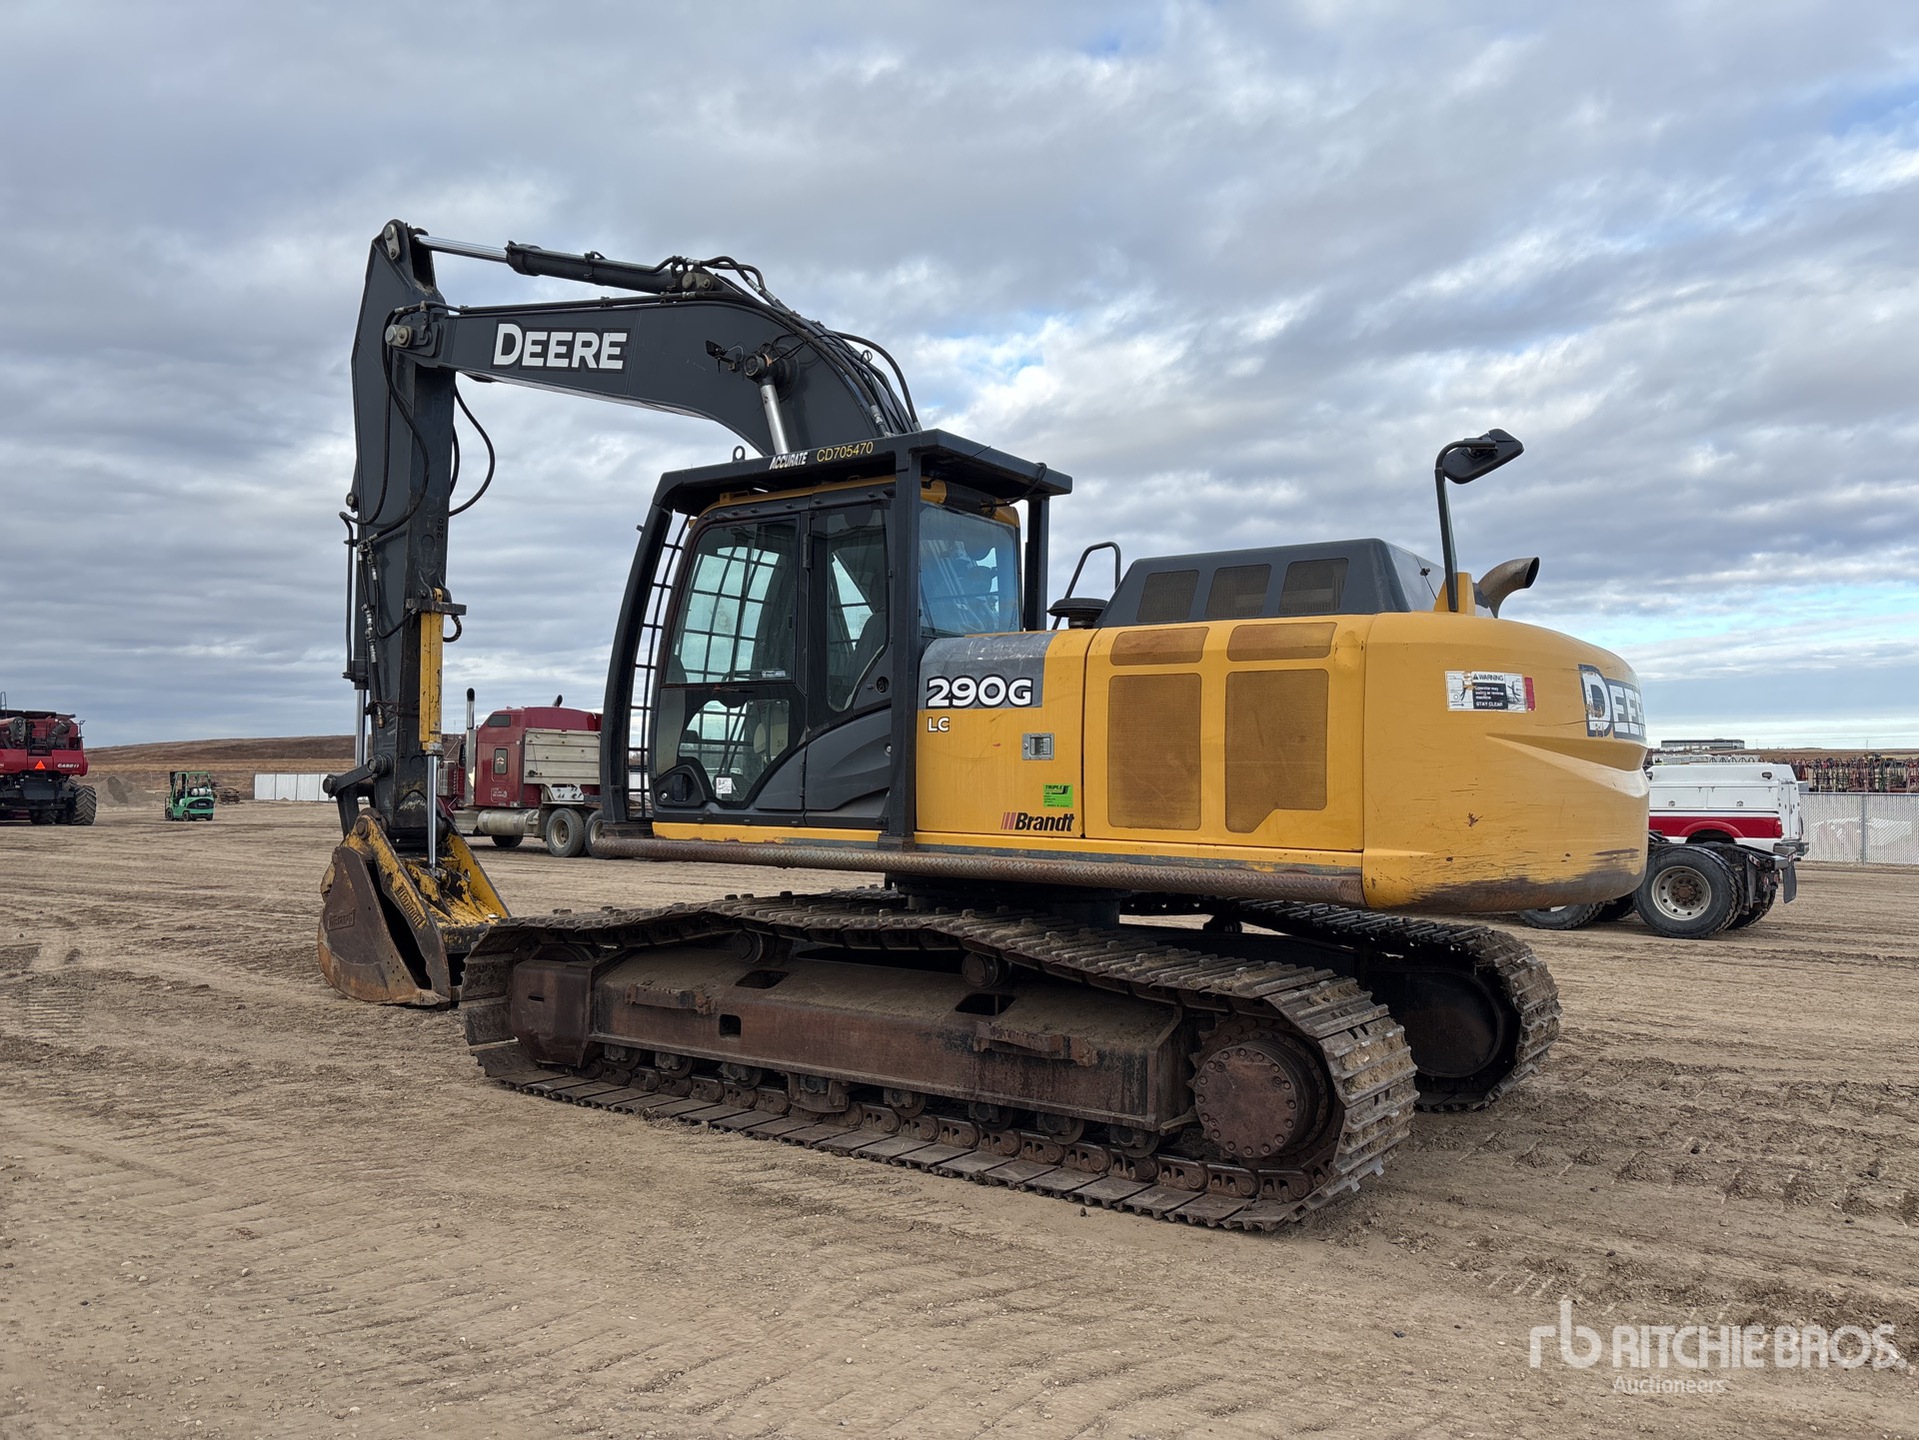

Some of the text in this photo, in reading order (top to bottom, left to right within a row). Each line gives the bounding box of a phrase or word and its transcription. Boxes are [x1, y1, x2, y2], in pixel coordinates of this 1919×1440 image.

[493, 323, 627, 369] DEERE
[769, 441, 874, 470] ACCURATE CD705470
[1480, 673, 1503, 681] WARNING
[926, 675, 1033, 707] 290G
[928, 717, 949, 732] LC
[1014, 812, 1074, 831] Brandt
